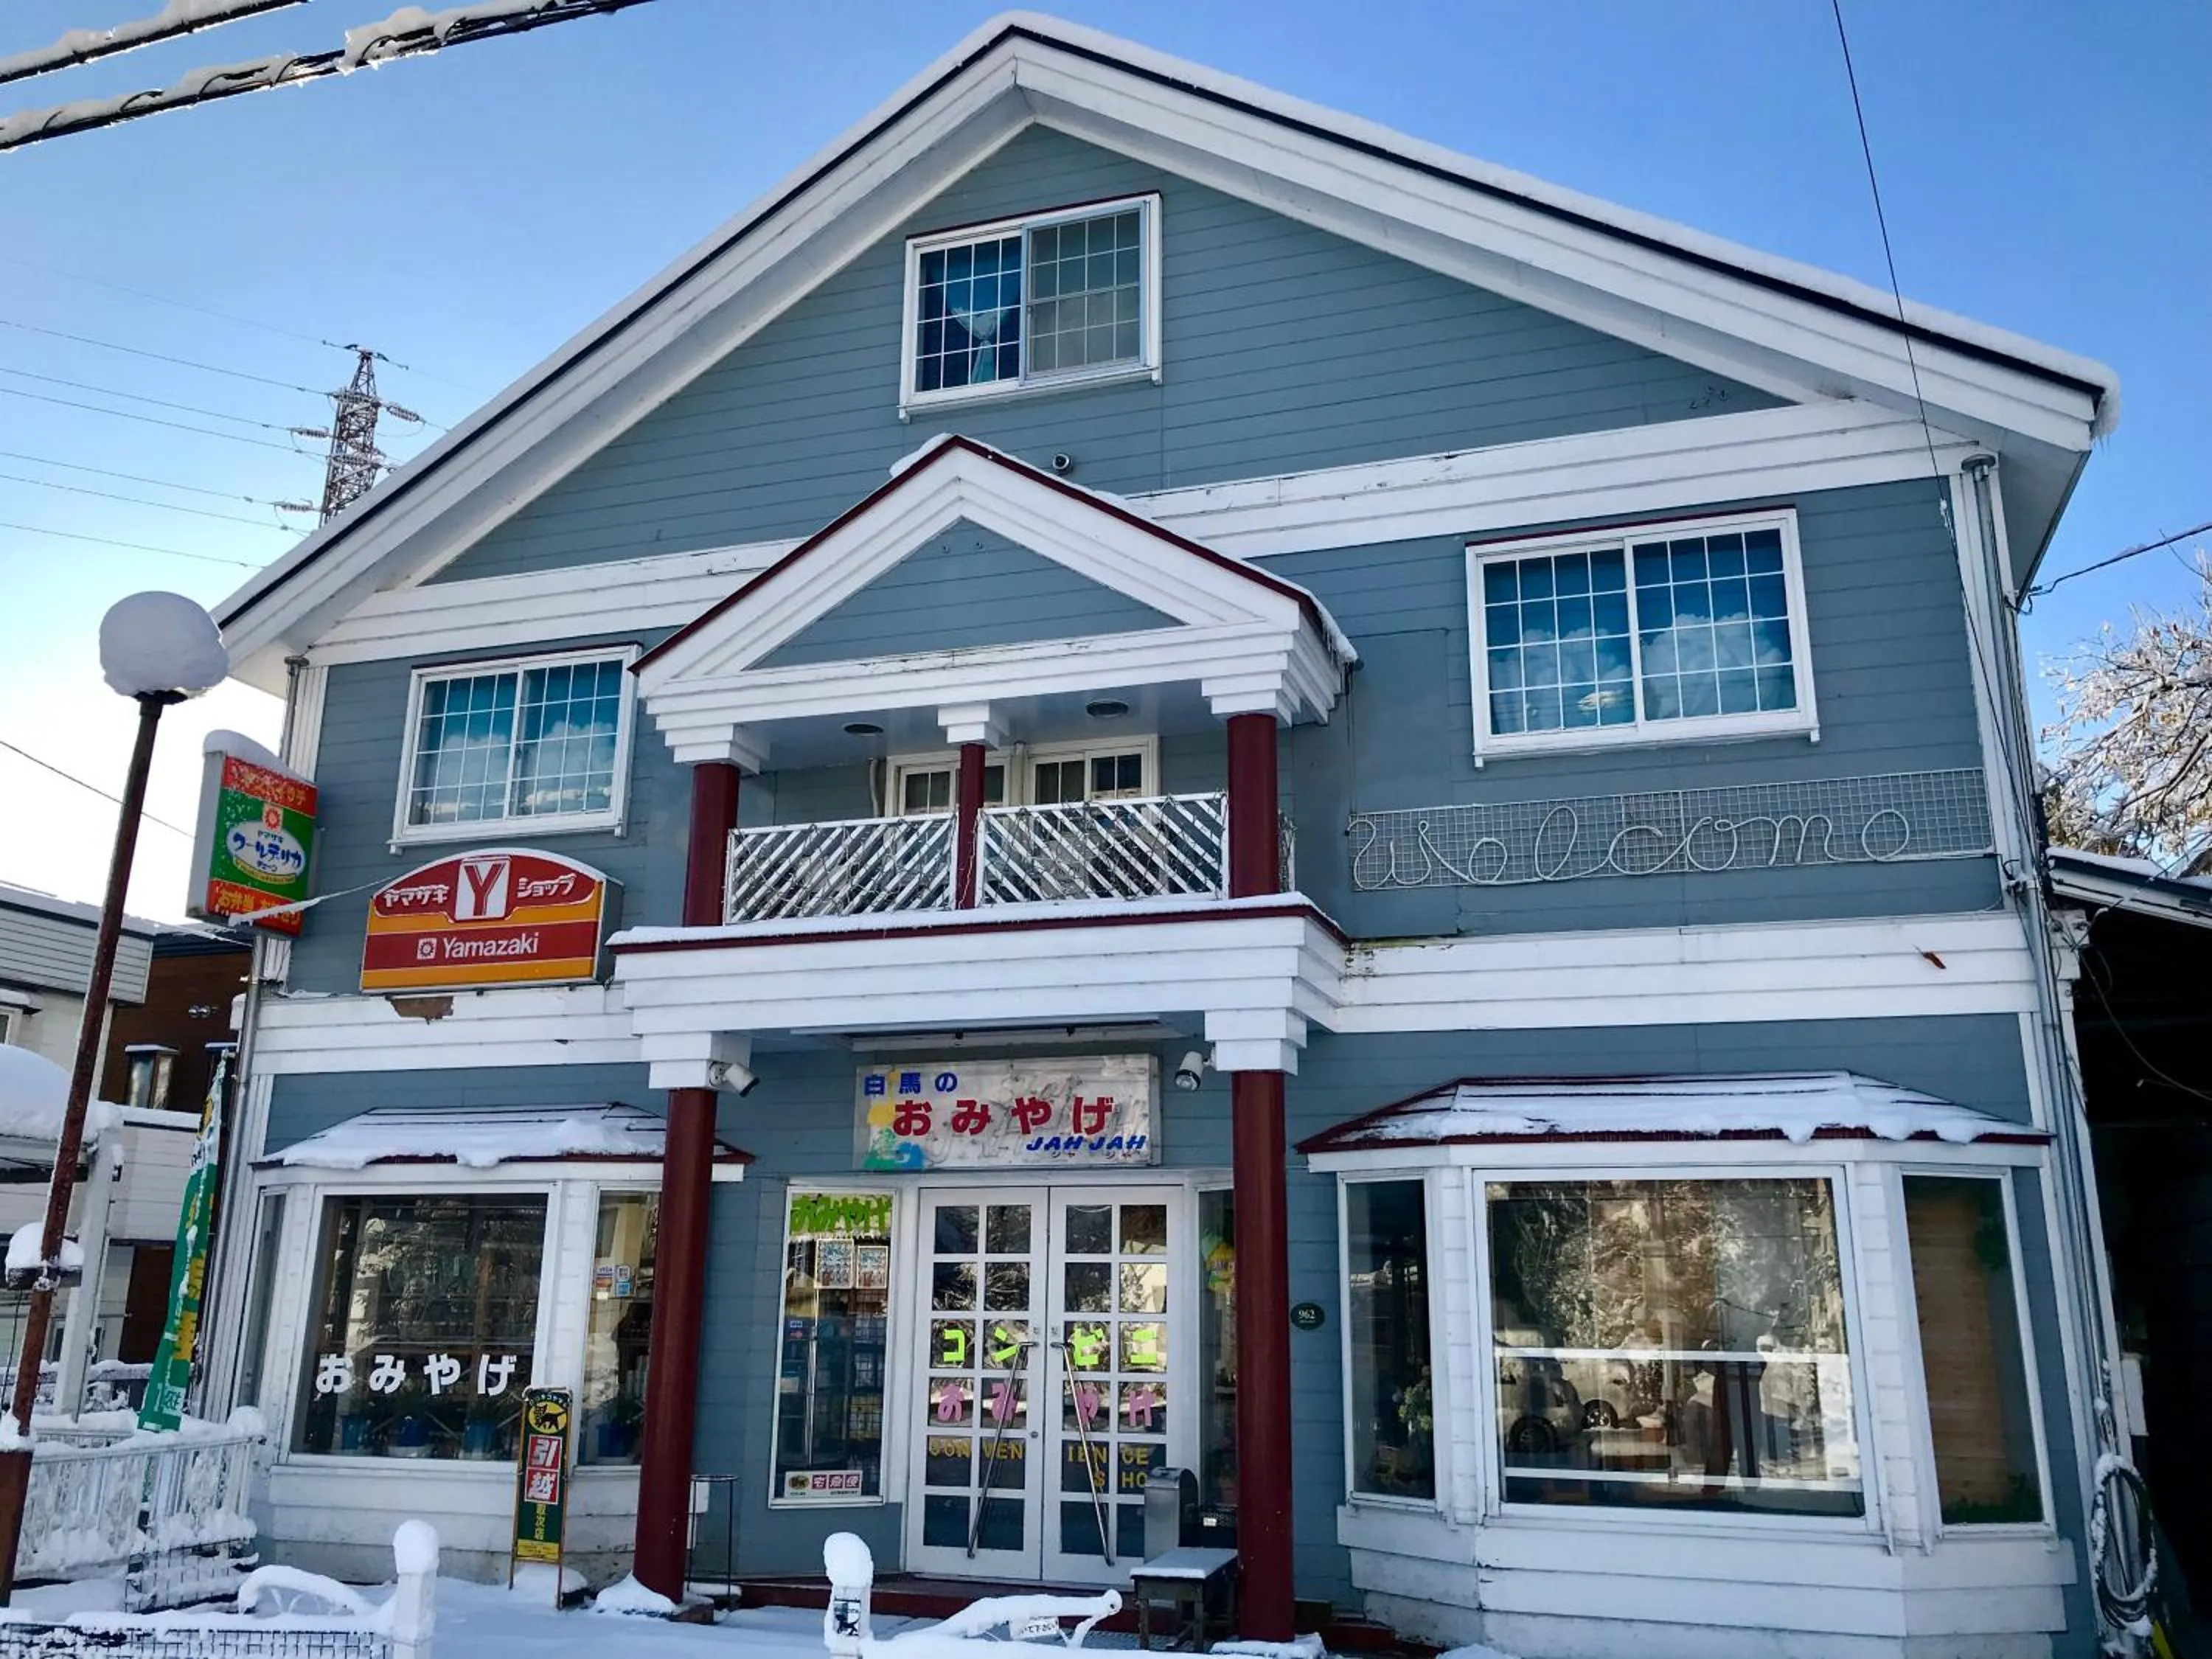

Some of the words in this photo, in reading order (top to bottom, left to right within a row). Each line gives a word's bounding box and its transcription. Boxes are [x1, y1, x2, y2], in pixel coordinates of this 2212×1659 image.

[383, 885, 449, 908] ヤマザキ
[463, 863, 507, 917] Y
[517, 873, 577, 898] ショップ
[443, 932, 539, 959] Yamazaki
[863, 1071, 959, 1096] 白馬の
[892, 1096, 1114, 1137] おみやげ
[1026, 1135, 1084, 1152] JAH
[1088, 1135, 1147, 1152] JAH
[315, 1353, 518, 1397] おみやげ
[1094, 1471, 1147, 1489] SHO
